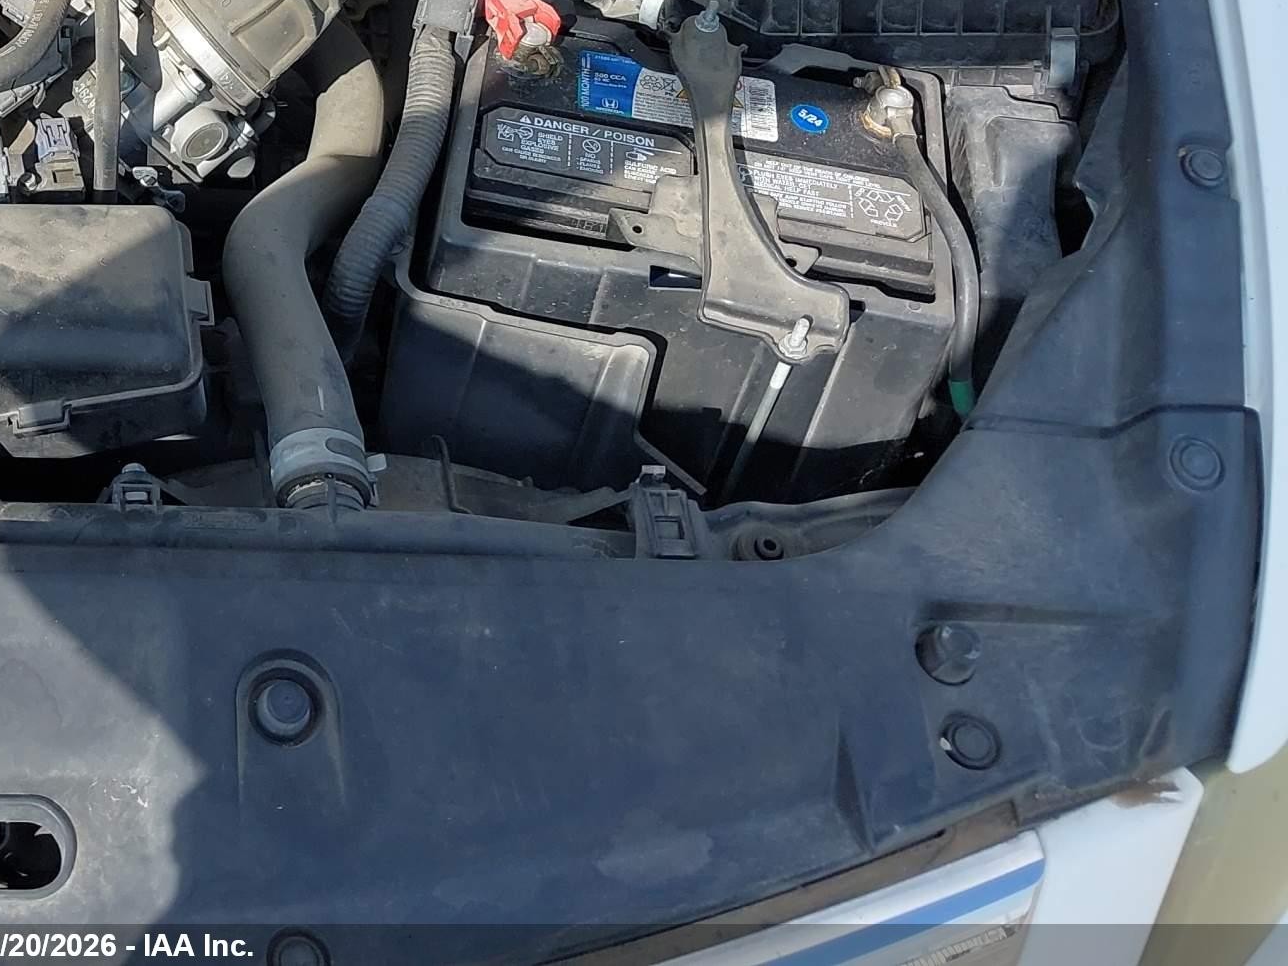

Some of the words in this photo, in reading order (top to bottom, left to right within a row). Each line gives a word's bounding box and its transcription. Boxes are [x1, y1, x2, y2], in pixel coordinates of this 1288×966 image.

[581, 68, 590, 95] MONTH
[798, 108, 824, 126] 5/24
[534, 117, 589, 136] DANGER
[604, 130, 654, 147] POISON
[660, 166, 676, 174] ACID
